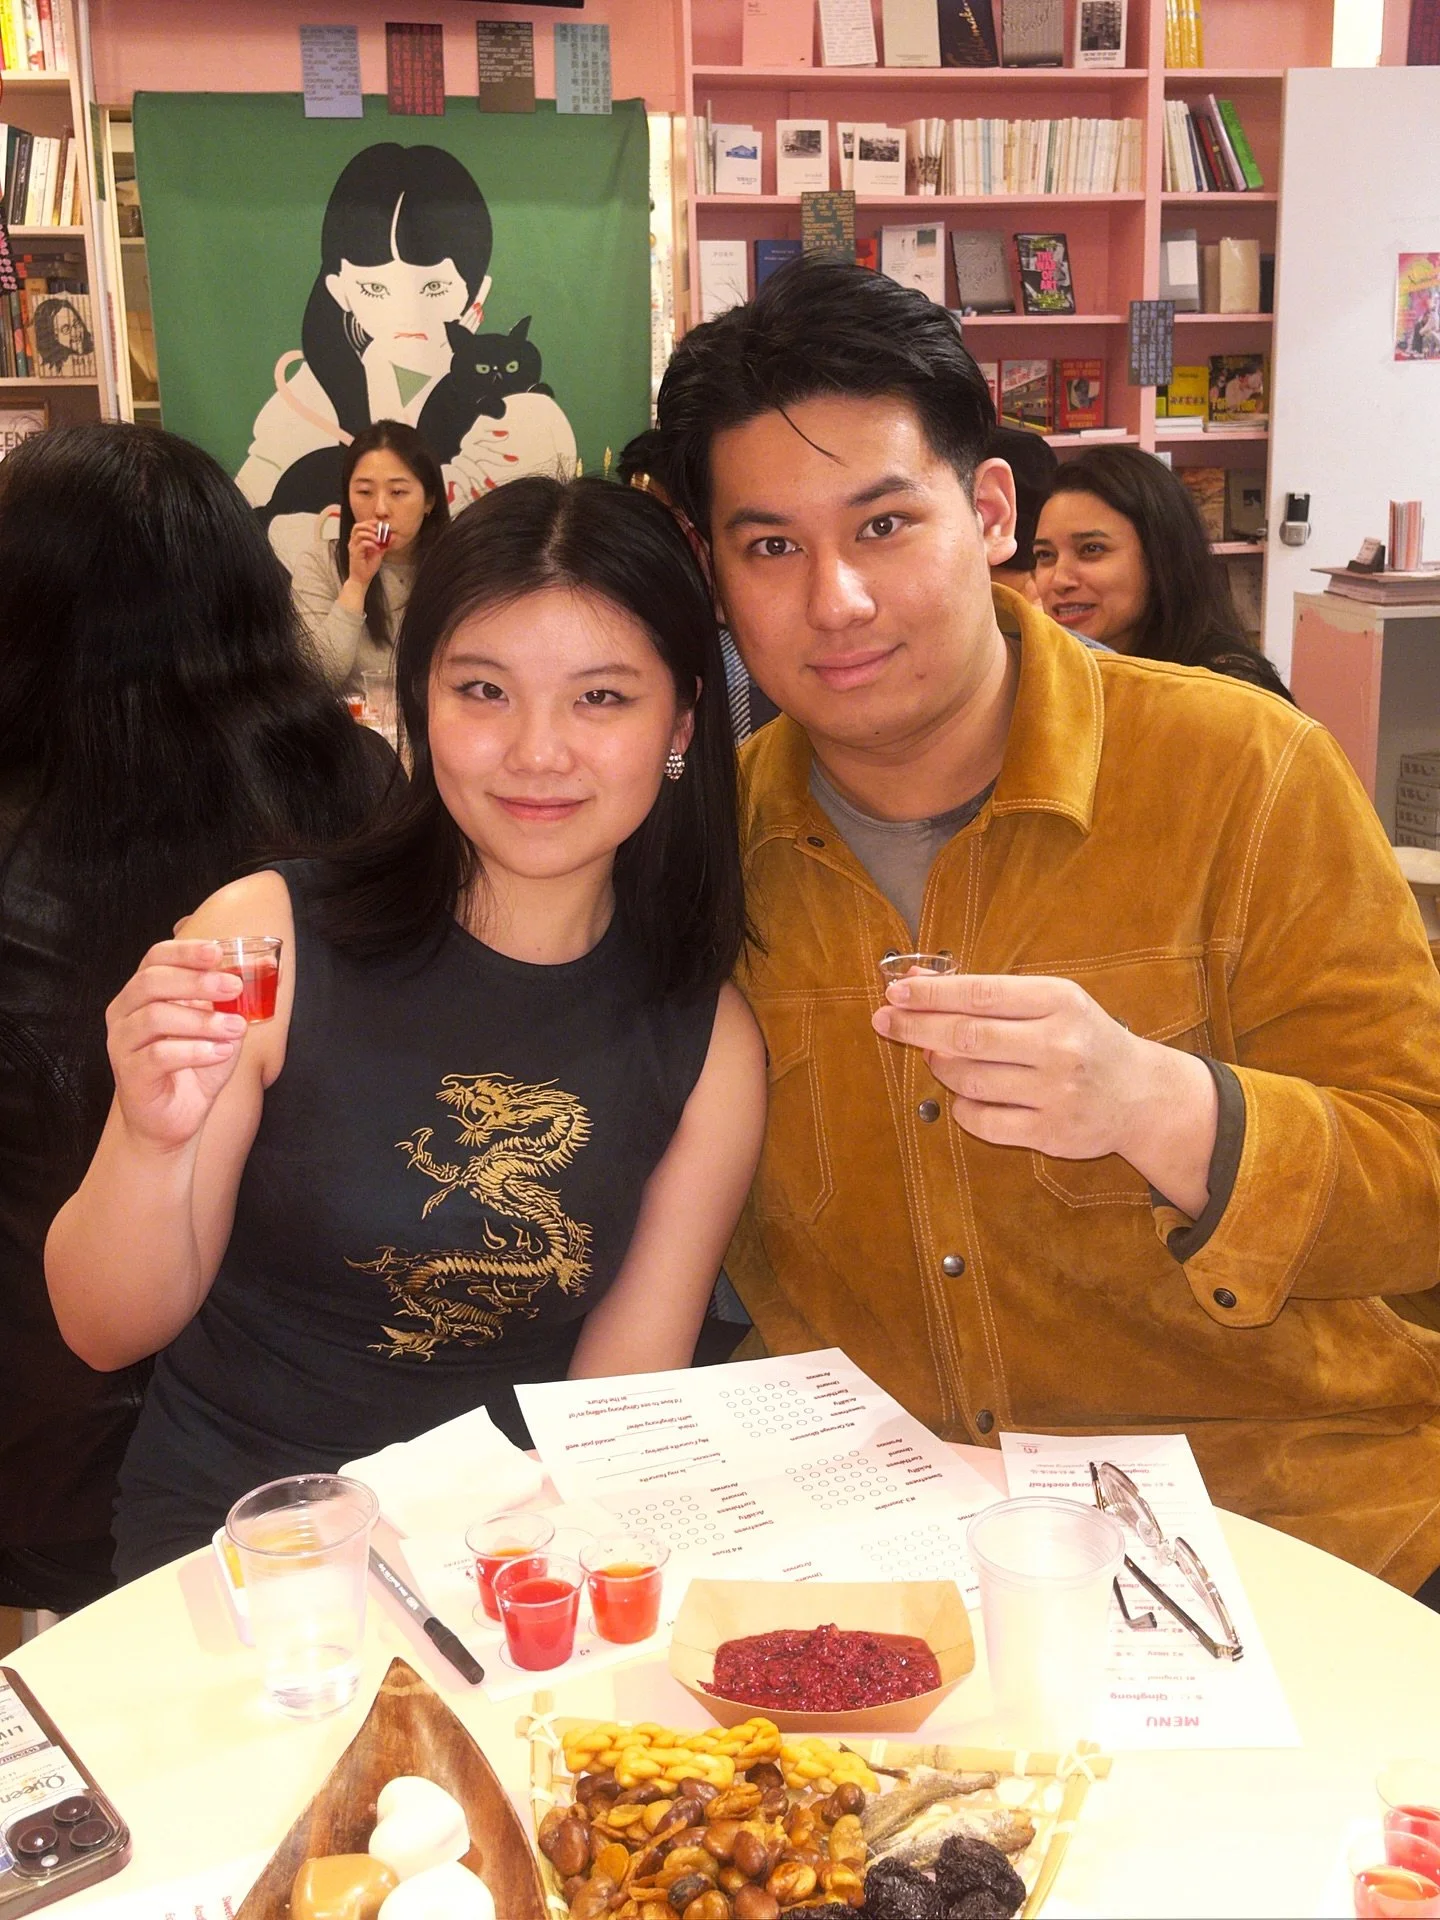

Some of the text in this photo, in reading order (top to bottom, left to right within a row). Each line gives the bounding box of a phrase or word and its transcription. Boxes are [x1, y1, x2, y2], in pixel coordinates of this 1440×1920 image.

[1036, 252, 1053, 260] THE
[1036, 261, 1056, 270] WAR
[1041, 271, 1054, 280] OF
[1040, 280, 1057, 290] ART
[814, 1388, 849, 1400] Earthiness
[833, 1397, 856, 1406] Acidity
[830, 1405, 866, 1416] Sweetness
[886, 1455, 923, 1467] Earthiness
[907, 1464, 932, 1474] Acidity
[905, 1473, 943, 1486] Sweetness
[717, 1500, 756, 1514] Earthiness
[738, 1509, 764, 1520] Acidity
[734, 1520, 774, 1534] Sweetness
[1110, 1692, 1168, 1701] Qinghong
[1146, 1716, 1199, 1727] MENU
[0, 1773, 65, 1803] Queen
